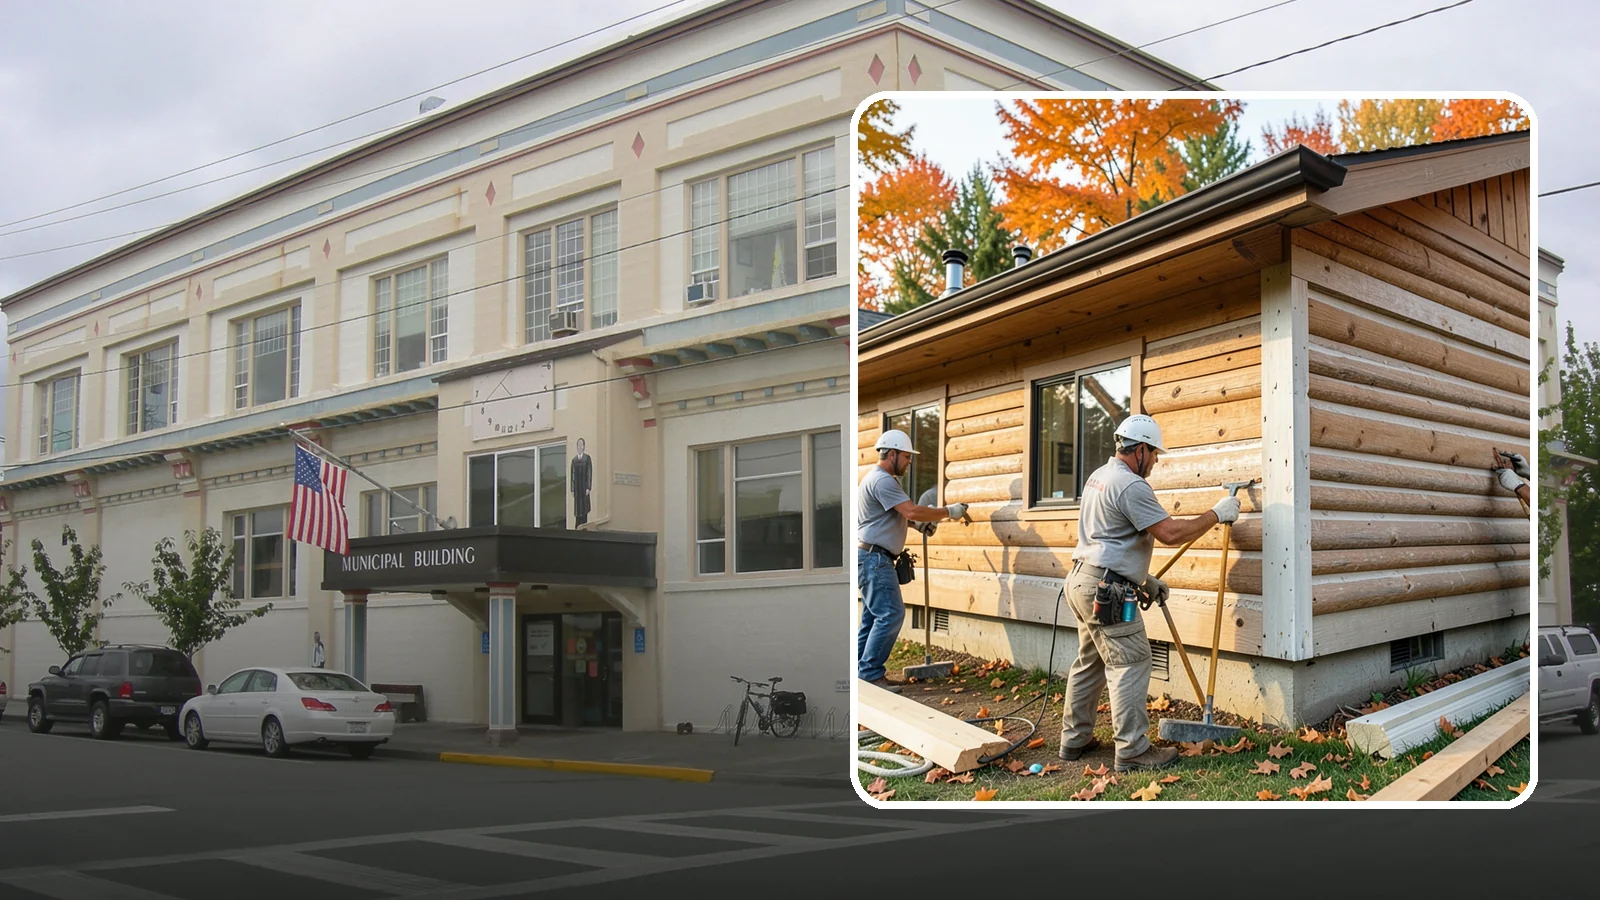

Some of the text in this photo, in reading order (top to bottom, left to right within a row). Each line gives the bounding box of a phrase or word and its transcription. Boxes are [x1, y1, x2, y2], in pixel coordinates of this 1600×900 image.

[546, 361, 552, 371] 6
[475, 389, 480, 398] 7
[480, 406, 485, 415] 8
[536, 402, 540, 411] 4
[487, 417, 493, 426] 9
[528, 414, 533, 422] 3
[494, 423, 500, 432] 10
[520, 420, 526, 429] 2
[507, 425, 514, 434] 12
[342, 546, 475, 572] MUNICIPAL BUILDING
